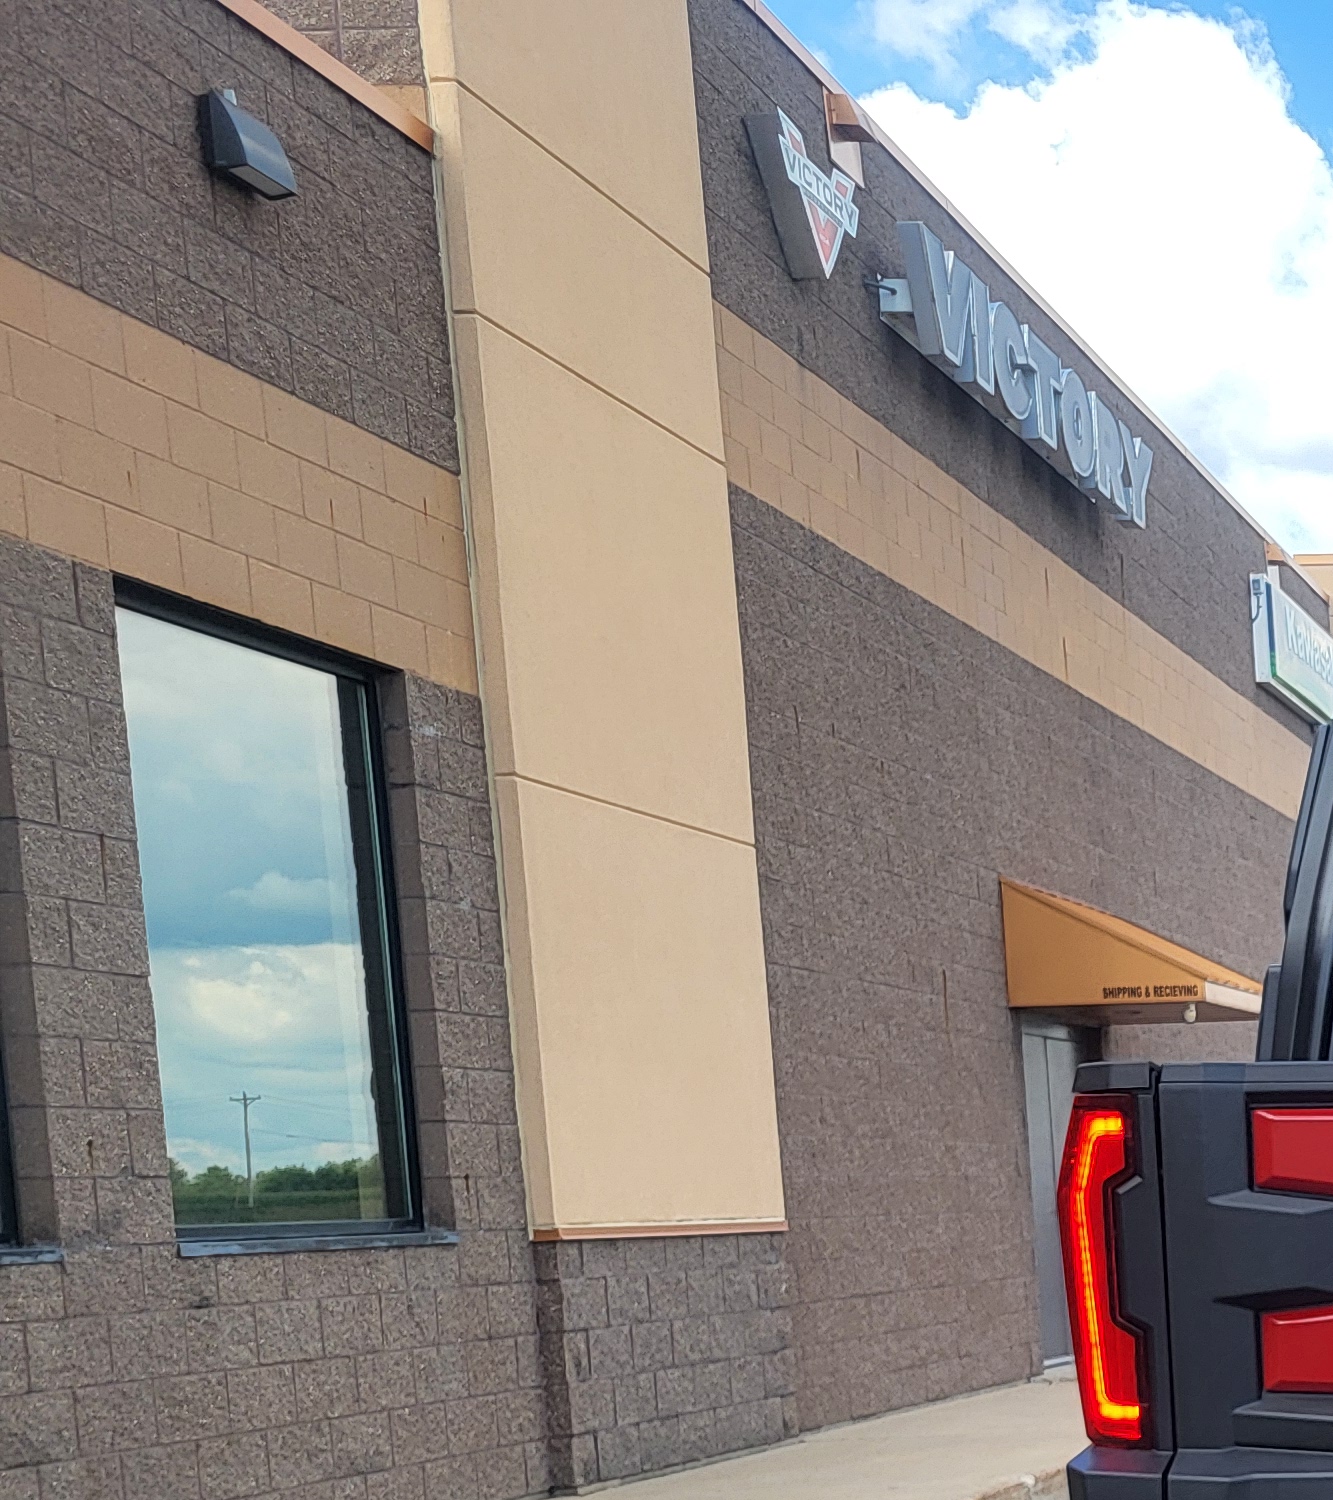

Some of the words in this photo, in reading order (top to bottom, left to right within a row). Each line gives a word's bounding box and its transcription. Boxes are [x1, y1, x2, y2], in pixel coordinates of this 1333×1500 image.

[786, 151, 856, 229] VICTORY
[899, 221, 1153, 529] VICTORY
[1102, 986, 1143, 999] SHIPPING
[1145, 985, 1151, 998] &
[1153, 985, 1199, 997] RECIEVING
